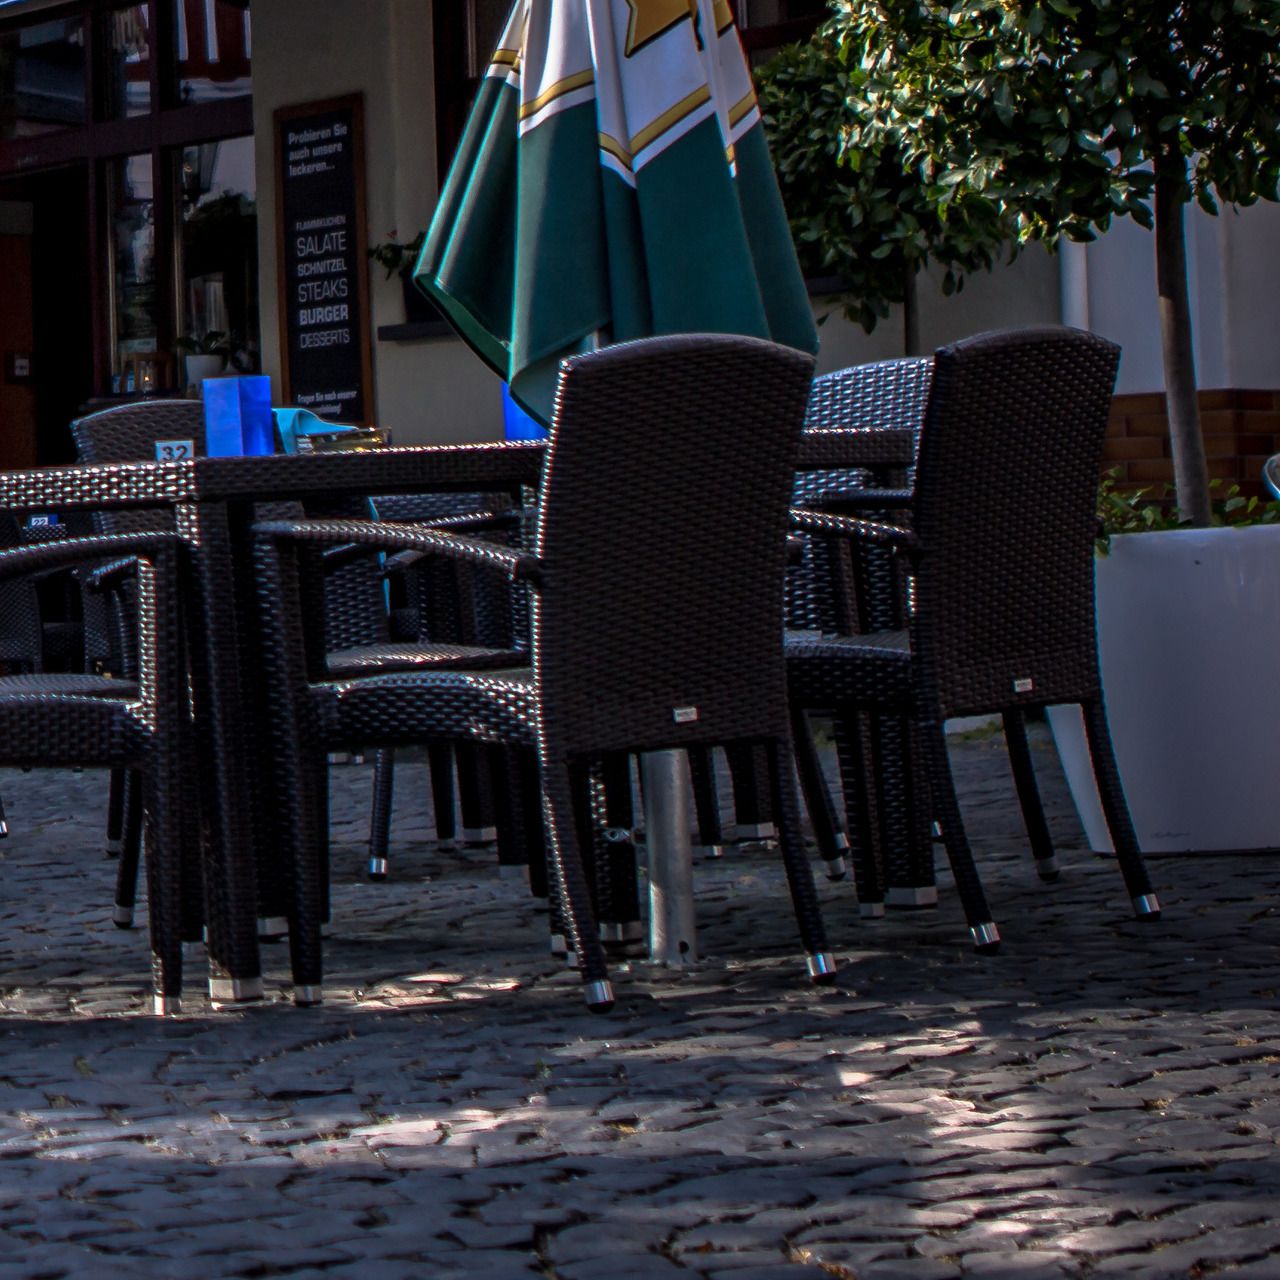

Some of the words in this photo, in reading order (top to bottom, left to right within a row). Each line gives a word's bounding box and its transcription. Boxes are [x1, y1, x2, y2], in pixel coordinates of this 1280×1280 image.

[288, 128, 331, 145] Probieren
[333, 123, 347, 137] Sie
[289, 146, 310, 161] auch
[312, 143, 342, 157] unsere
[297, 231, 346, 257] SALATE
[297, 258, 347, 277] SCHNITZEL
[298, 278, 348, 302] STEAKS
[300, 304, 349, 325] BURGER
[300, 328, 350, 349] DESSERTS
[162, 445, 188, 461] 32
